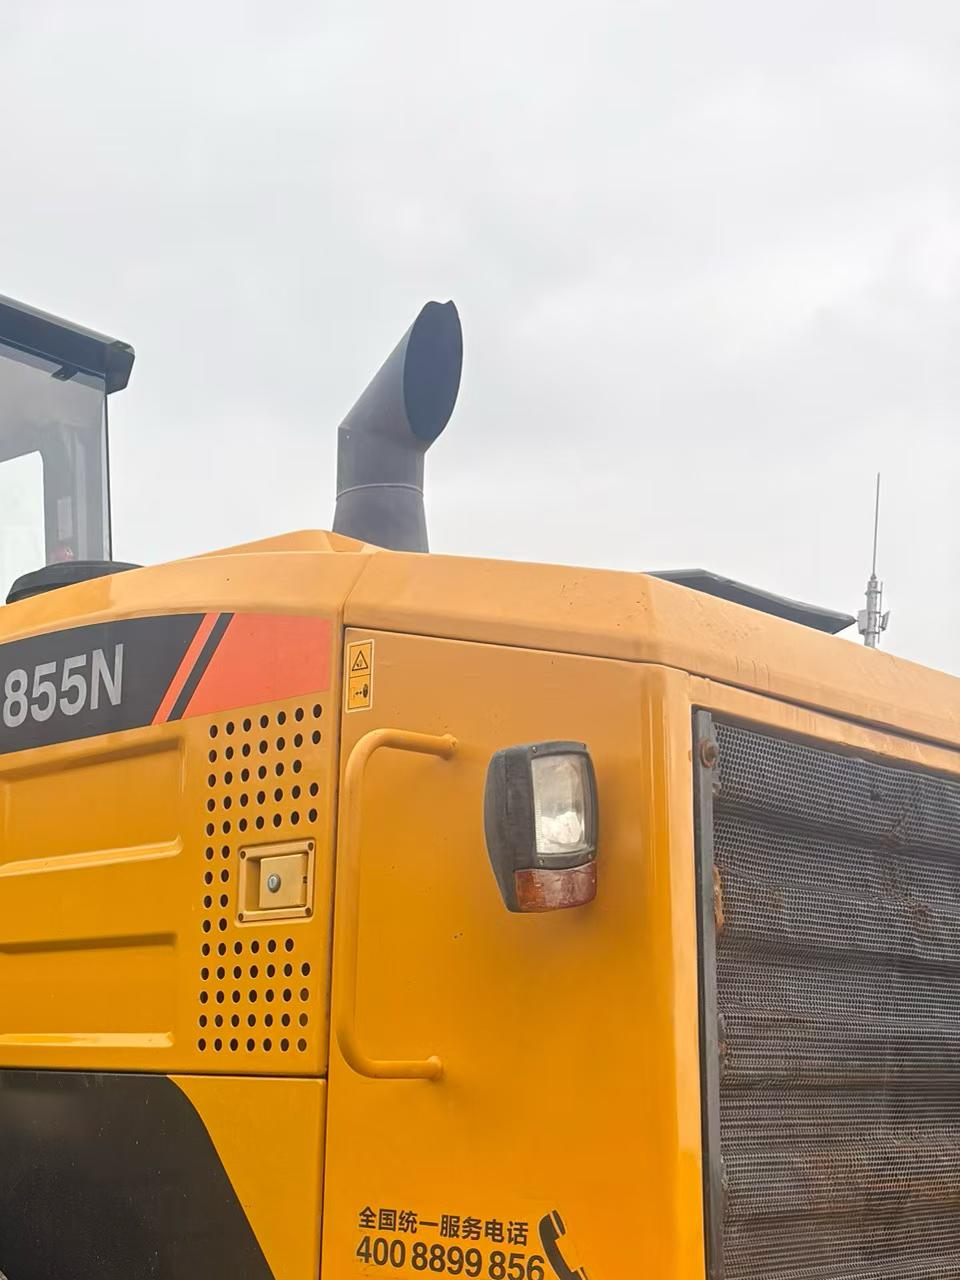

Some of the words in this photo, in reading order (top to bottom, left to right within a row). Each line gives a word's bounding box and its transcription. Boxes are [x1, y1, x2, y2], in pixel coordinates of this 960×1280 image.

[2, 643, 124, 728] 855N
[358, 1206, 529, 1247] 全国统一服务电话
[356, 1235, 407, 1269] 400
[411, 1241, 483, 1278] 8899
